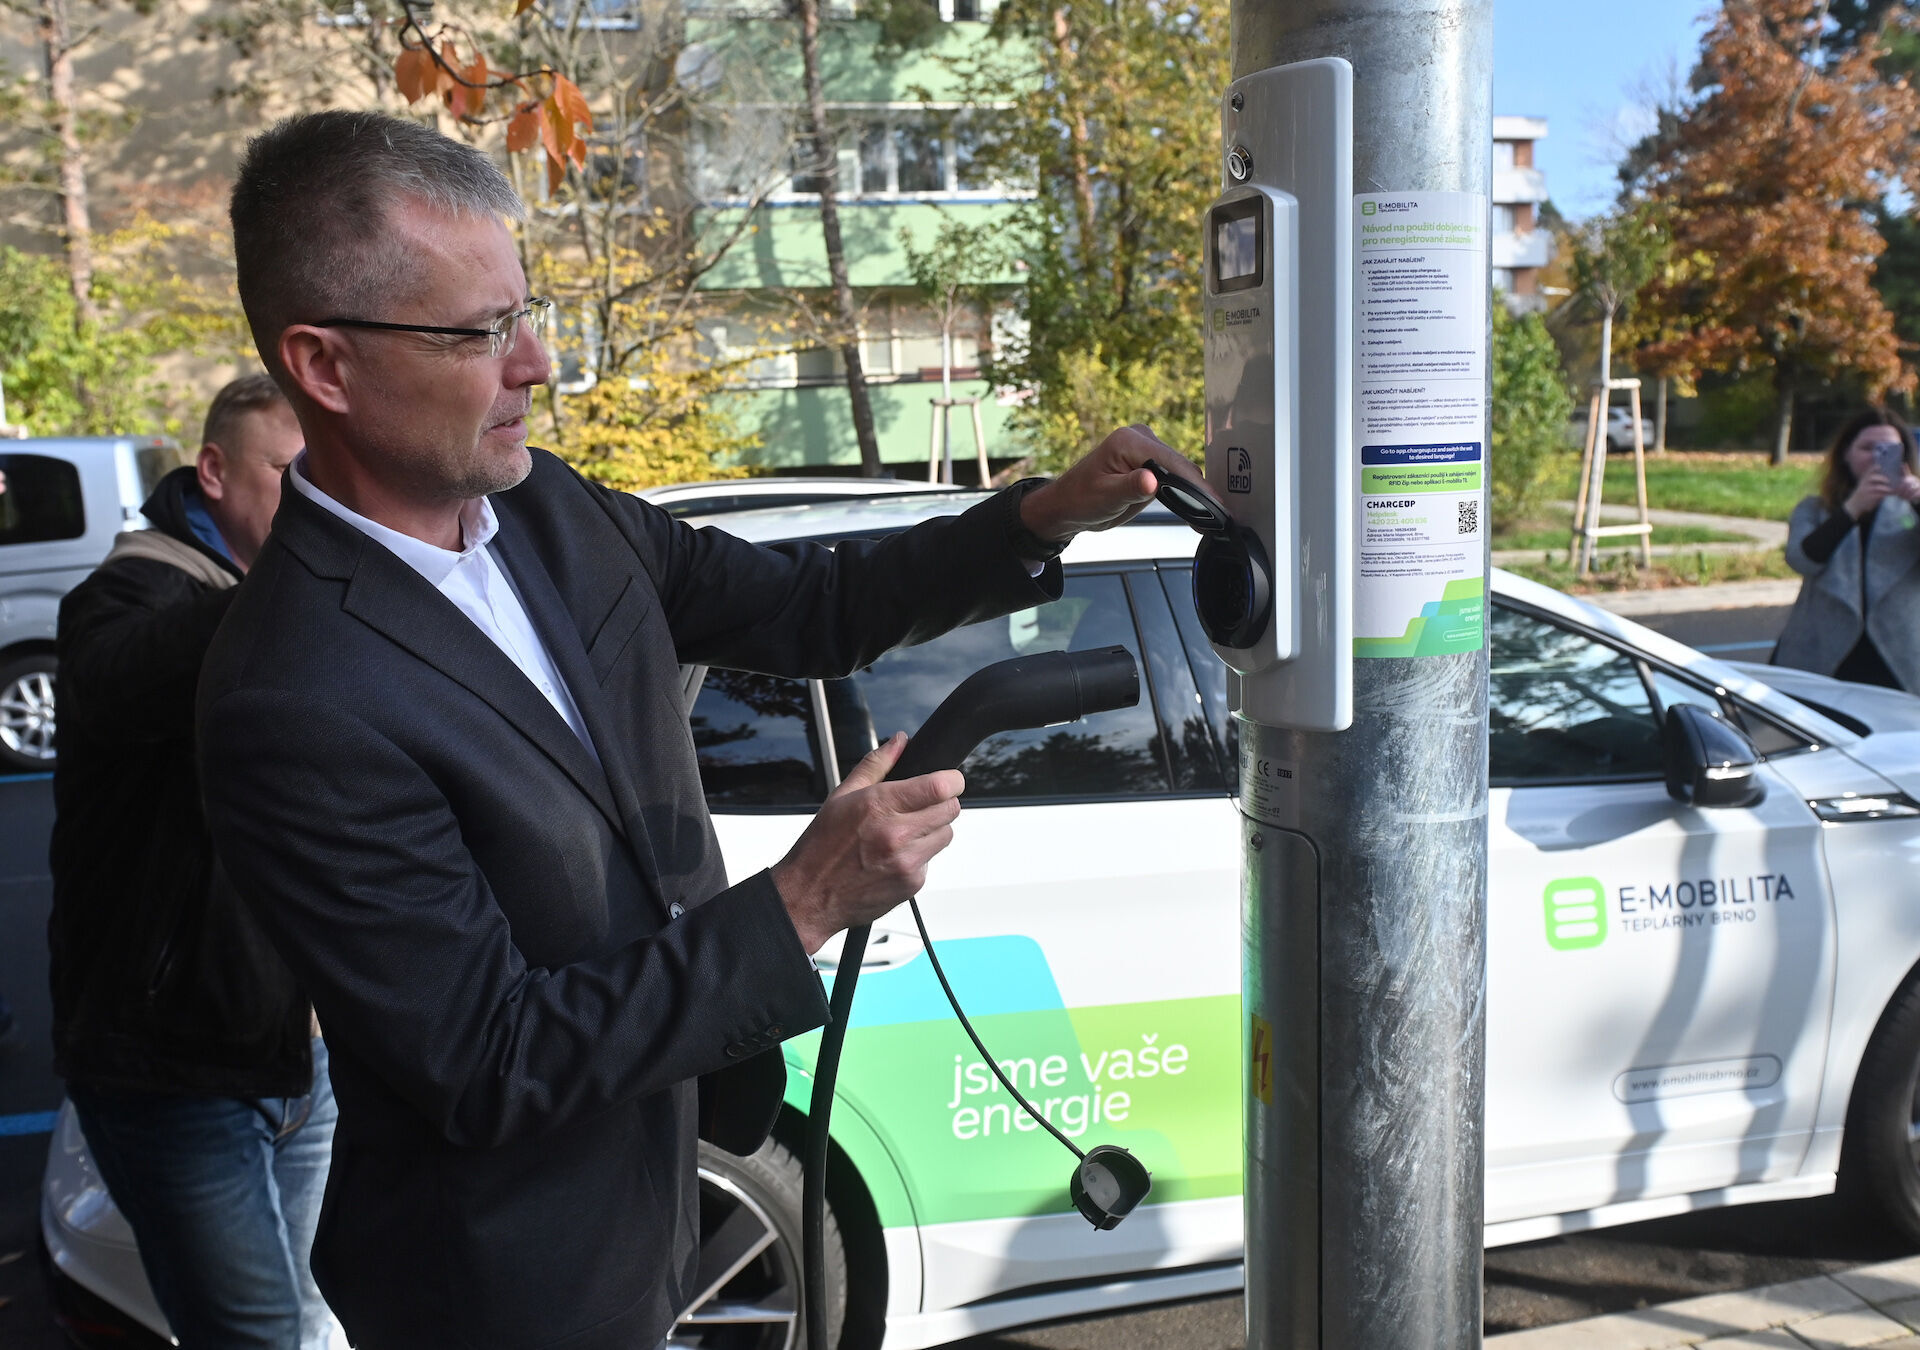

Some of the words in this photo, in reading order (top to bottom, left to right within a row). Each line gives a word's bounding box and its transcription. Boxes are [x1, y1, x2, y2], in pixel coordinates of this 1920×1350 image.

[1378, 201, 1418, 209] E-MOBILITA
[1362, 223, 1392, 233] Návod
[1406, 222, 1435, 233] použití
[1362, 238, 1378, 247] pro
[1380, 235, 1444, 245] neregistrované
[1226, 307, 1260, 320] E-MOBILITA
[1399, 386, 1426, 394] NABÍJENÍ?
[1396, 447, 1437, 455] app.chargeup.cz
[1230, 475, 1249, 488] RFID
[1367, 500, 1416, 509] CHARGEUP
[1620, 873, 1795, 913] E-MOBILITA
[1622, 912, 1704, 932] TEPLÁRNY
[1712, 909, 1757, 925] BRNO
[948, 1054, 1068, 1109] jsme
[1080, 1032, 1189, 1083] vaše
[951, 1084, 1131, 1140] energie
